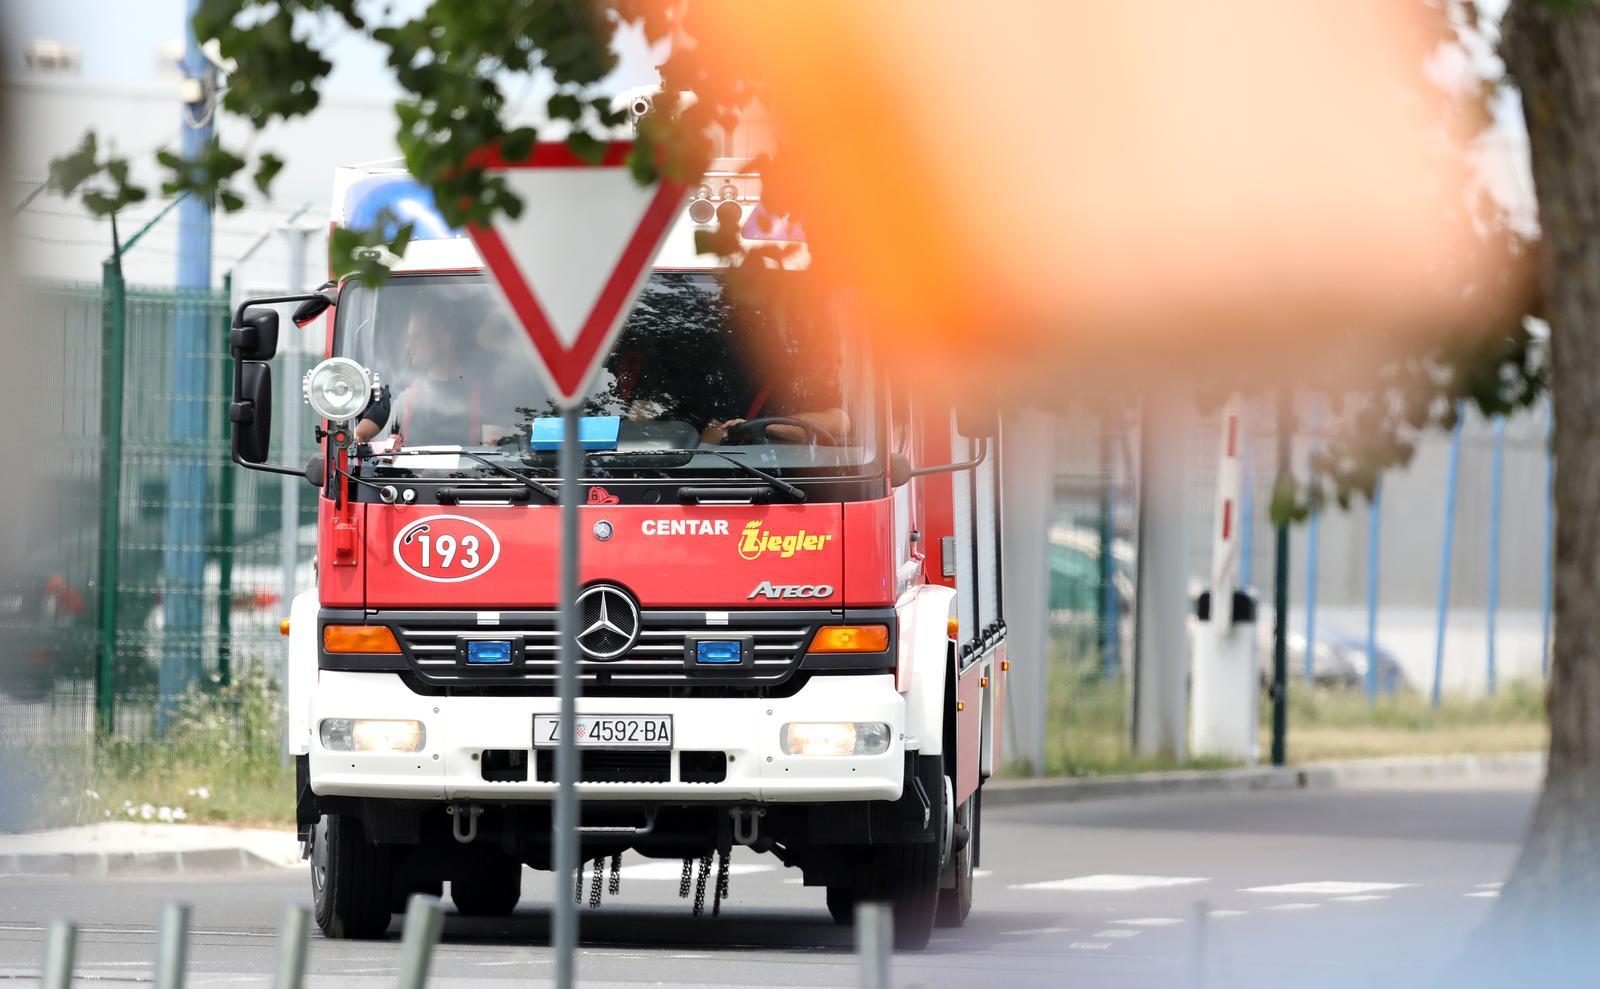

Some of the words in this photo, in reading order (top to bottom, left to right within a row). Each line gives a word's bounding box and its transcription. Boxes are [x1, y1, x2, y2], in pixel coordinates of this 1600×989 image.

[641, 519, 729, 536] CENTAR
[738, 523, 832, 560] Ziegler
[418, 534, 480, 569] 193
